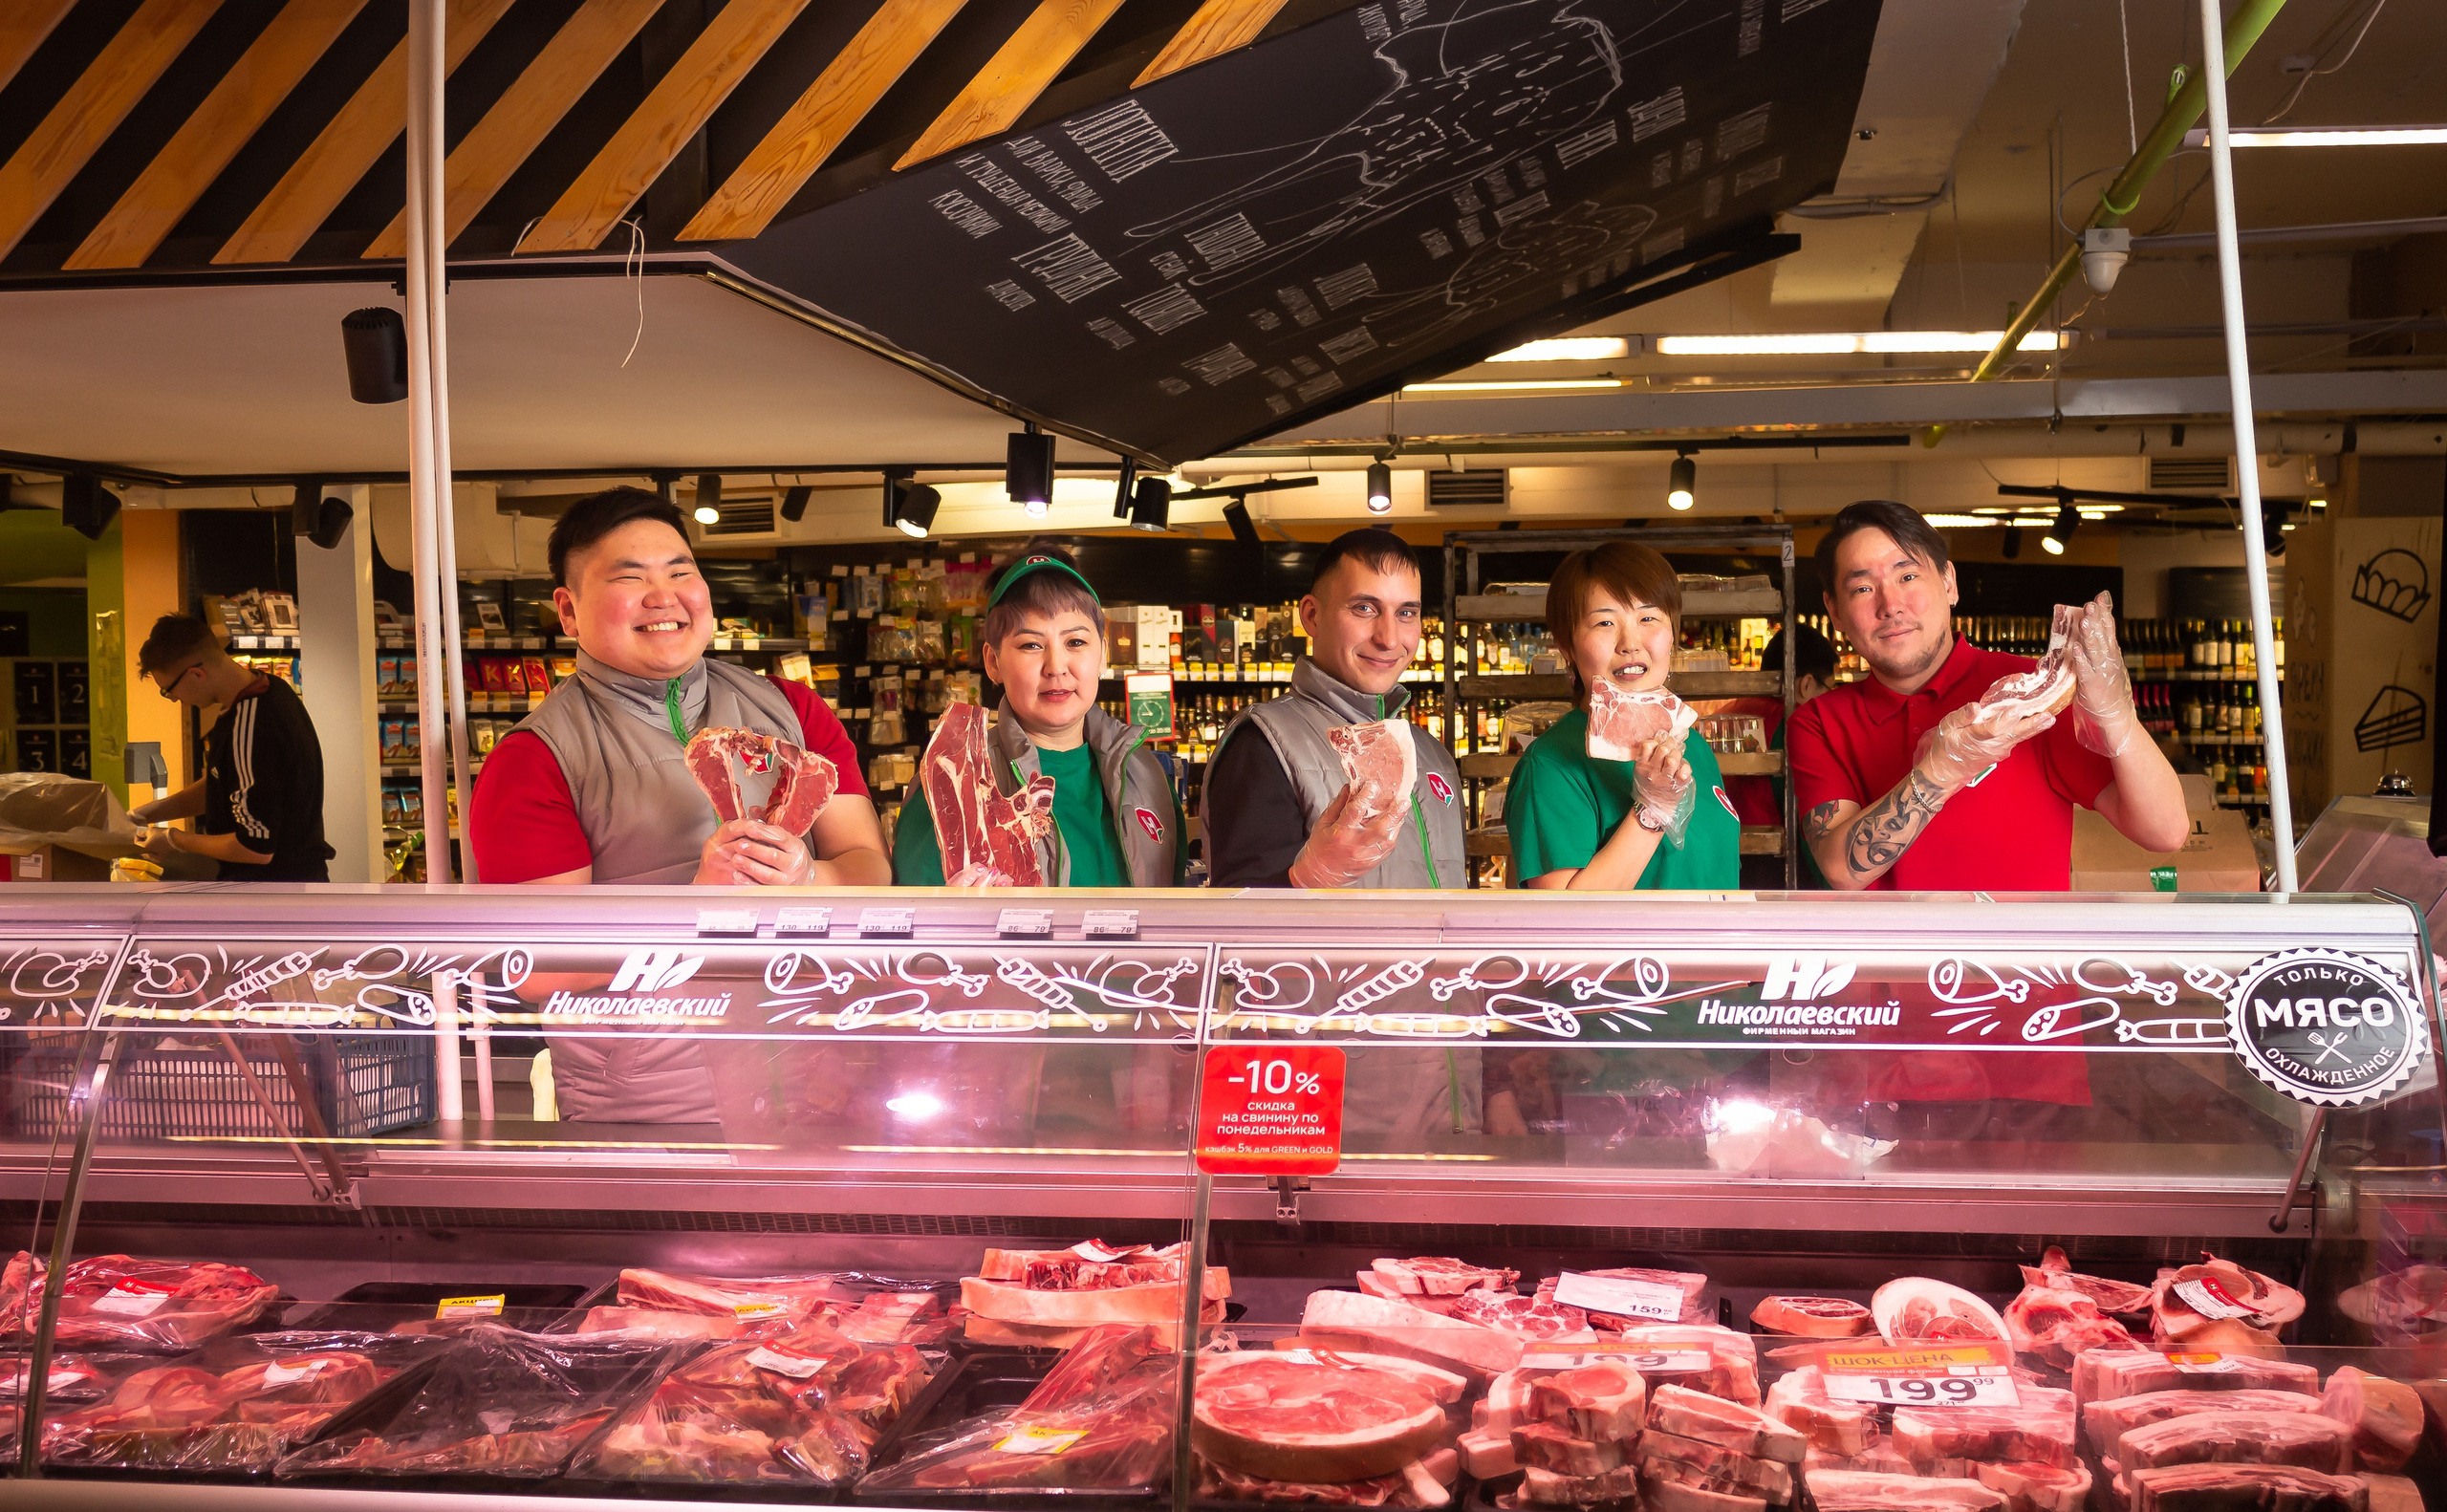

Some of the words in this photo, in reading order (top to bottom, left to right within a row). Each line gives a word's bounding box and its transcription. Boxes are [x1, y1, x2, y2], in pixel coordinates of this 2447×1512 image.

[1004, 135, 1047, 159] ДЛЯ
[1060, 98, 1180, 184] ЛОПАТКА
[956, 152, 985, 169] И
[1022, 150, 1077, 192] ВАРКИ,
[965, 160, 1031, 207] ТУШЕНИЯ
[1056, 180, 1104, 213] ФАРША
[928, 188, 1003, 240] КУСОЧКАМИ
[1183, 211, 1267, 271] ПАШИНА
[1010, 231, 1123, 305] ГРУДИНКА
[1784, 545, 1793, 561] 2
[32, 685, 38, 703] 1
[73, 683, 85, 703] 2
[31, 750, 44, 771] 3
[72, 750, 87, 770] 4
[2273, 967, 2364, 986] ТОЛЬКО
[543, 991, 732, 1017] Николаевский
[1697, 1000, 1900, 1026] Николаевский
[2254, 997, 2394, 1027] МЯСО
[2264, 1047, 2395, 1085] ОХЛАЖДЕННОЕ
[1247, 1101, 1295, 1111] скидка
[1217, 1125, 1325, 1135] понедельникам
[1222, 1113, 1239, 1122] на
[1241, 1113, 1299, 1125] свинину
[1301, 1114, 1319, 1123] по
[1238, 1143, 1252, 1153] 5%
[1629, 1304, 1662, 1315] 159
[1833, 1352, 1954, 1366] ШОК-ЦЕНА
[1870, 1378, 1978, 1401] 199
